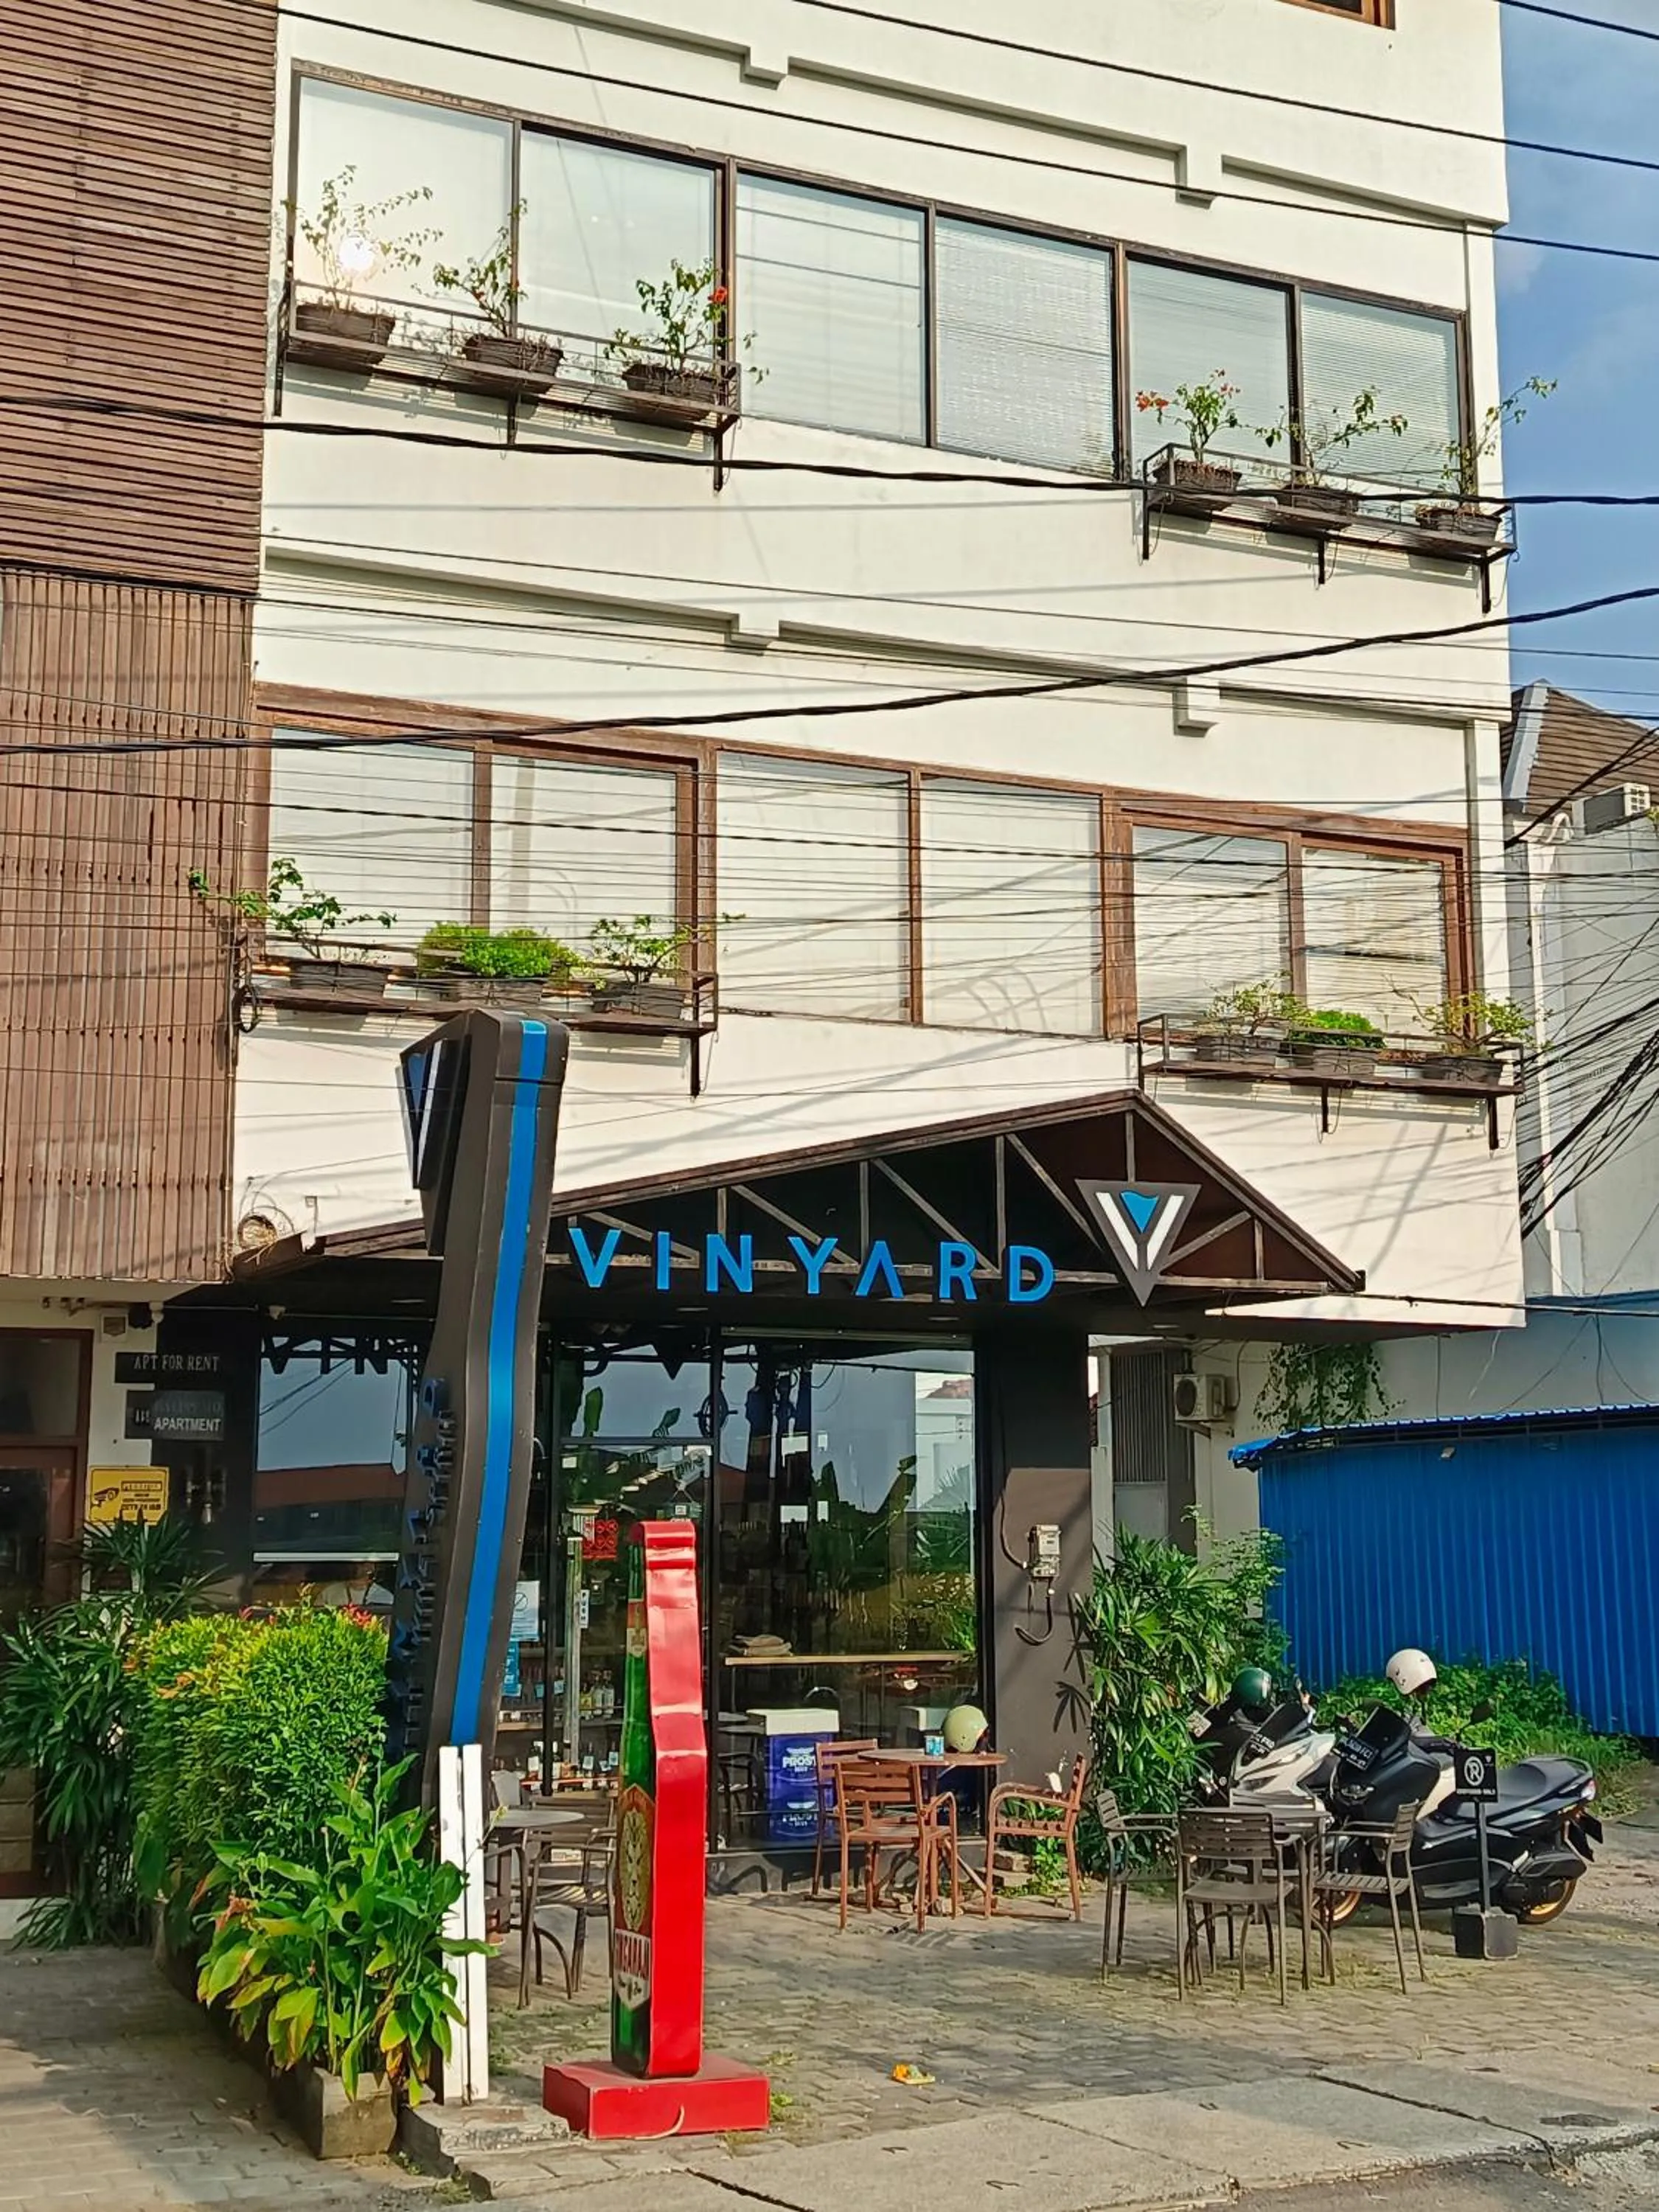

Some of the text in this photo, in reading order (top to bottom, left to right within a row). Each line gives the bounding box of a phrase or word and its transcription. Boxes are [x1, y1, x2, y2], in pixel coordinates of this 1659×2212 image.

[568, 1228, 1054, 1302] VINYARD
[133, 1354, 220, 1372] APT FOR RENT
[153, 1417, 221, 1432] APARTMENT
